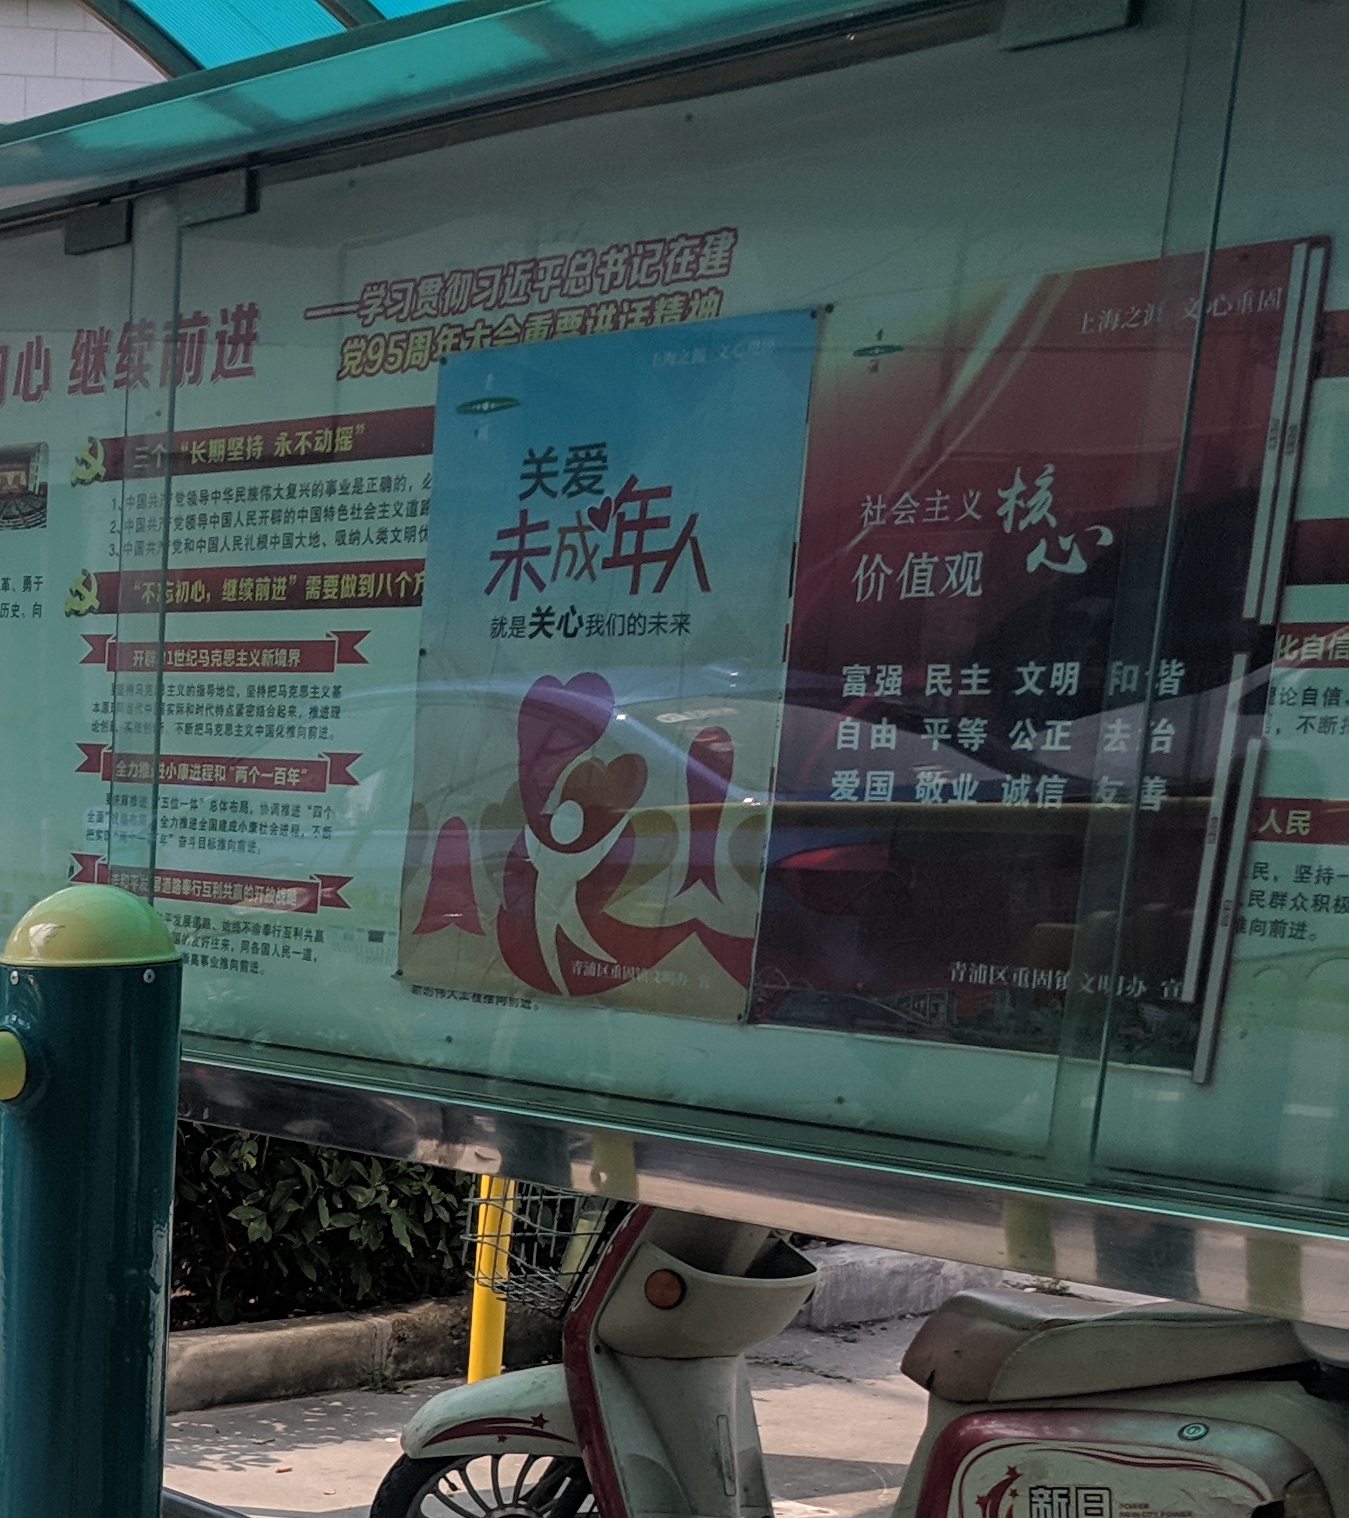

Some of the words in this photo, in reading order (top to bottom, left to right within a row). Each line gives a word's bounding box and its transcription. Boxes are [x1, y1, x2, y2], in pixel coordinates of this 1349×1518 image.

[68, 302, 262, 396] 继续前进
[273, 424, 366, 458] 永不动摇”
[518, 441, 609, 501] 关爱
[860, 489, 983, 527] 社会主义
[483, 474, 712, 602] 未成年人
[851, 551, 984, 603] 价值观
[490, 605, 691, 640] 就是关心我们的未来
[841, 663, 903, 697] 富强
[925, 663, 991, 697] 民主
[1015, 661, 1080, 696] 文明
[836, 716, 898, 751] 自由
[921, 716, 988, 752] 平等
[1008, 717, 1072, 752] 公正
[830, 769, 895, 803] 爱国
[914, 767, 980, 805] 敬业
[1001, 773, 1068, 809] 诚信
[1259, 808, 1312, 836] 人民
